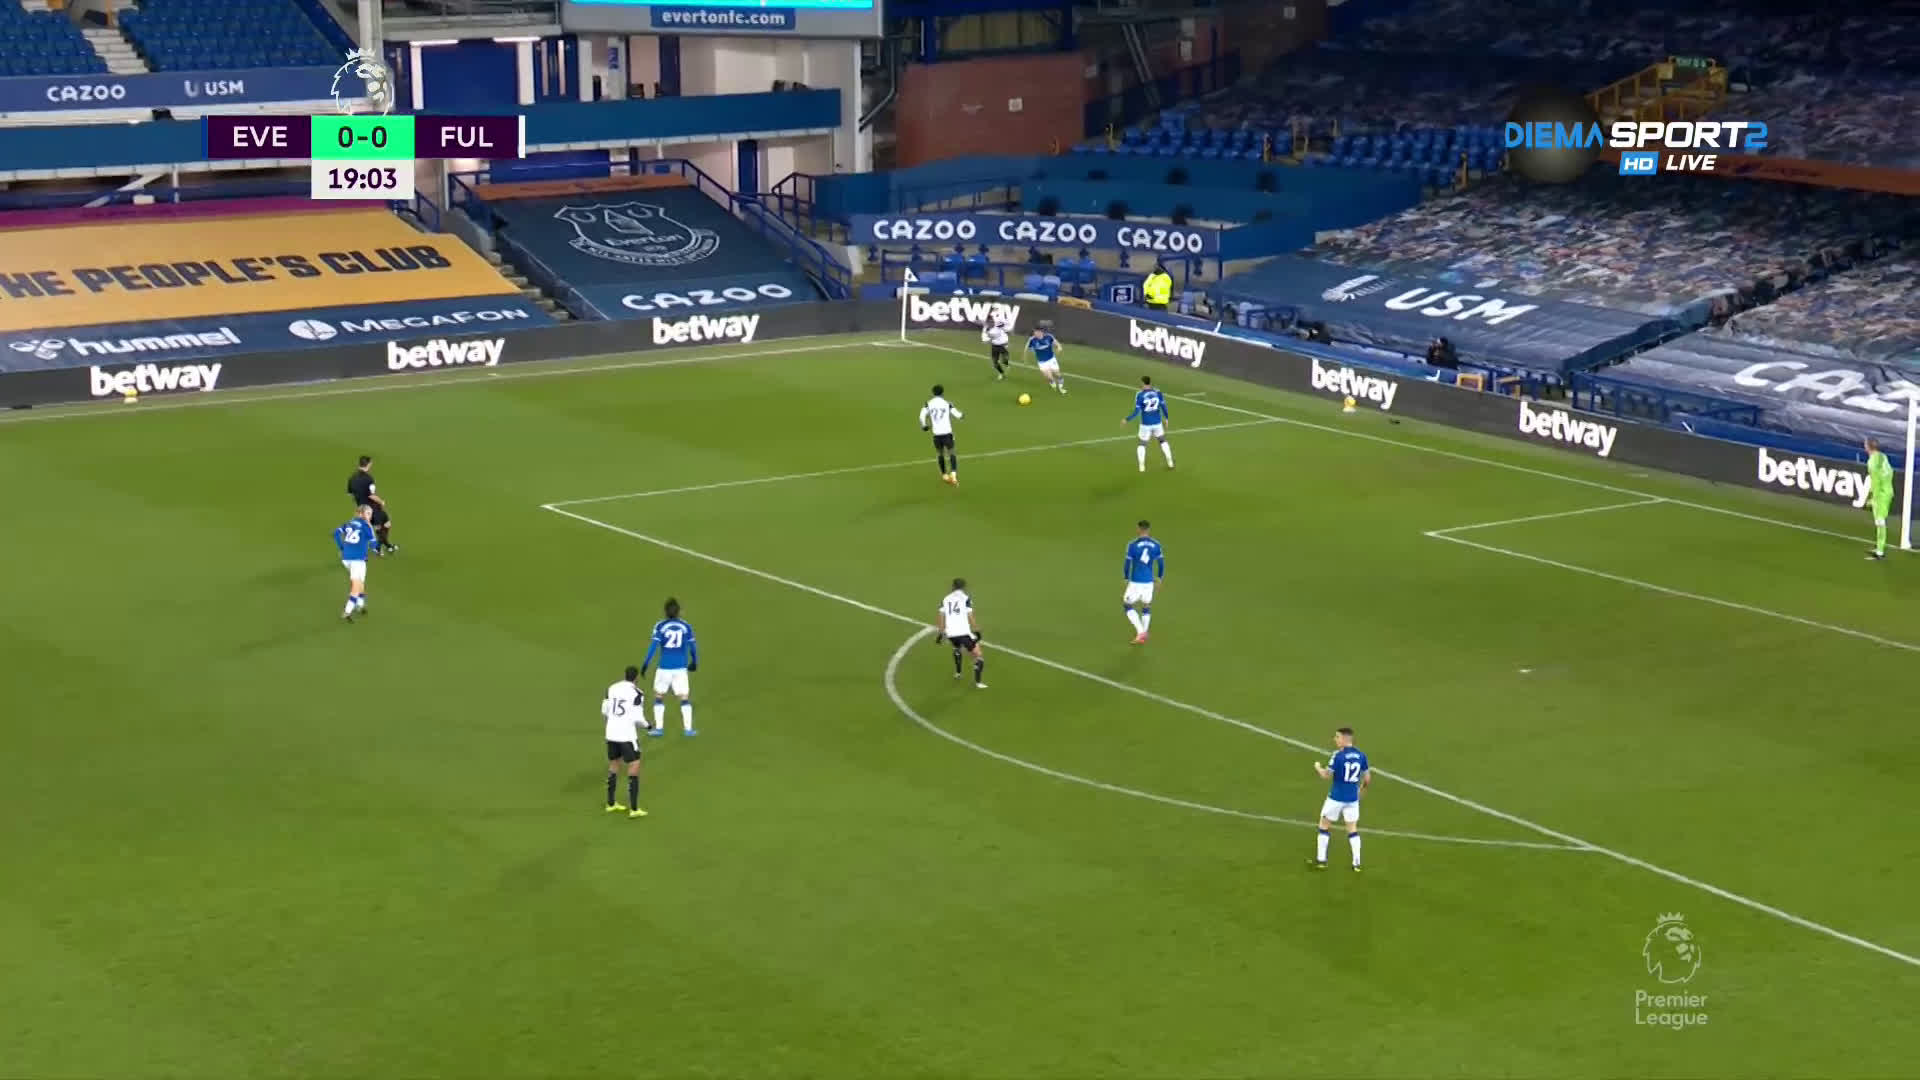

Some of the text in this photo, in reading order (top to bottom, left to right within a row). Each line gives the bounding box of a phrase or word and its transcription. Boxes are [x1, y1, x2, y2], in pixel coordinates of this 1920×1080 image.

[662, 10, 786, 25] evertonfc.com
[46, 84, 126, 102] CAZOO
[205, 79, 245, 96] USM
[873, 219, 1203, 254] CAZOO CAZOO CAZOO
[0, 245, 452, 299] HE PEOPLE'S CLUB
[621, 283, 793, 311] CAZOO
[909, 294, 1020, 331] betway
[1384, 287, 1539, 325] USM
[340, 308, 530, 334] MEGAFON
[652, 314, 760, 345] betway
[68, 326, 242, 356] hummel
[387, 338, 506, 371] betway
[1129, 319, 1206, 368] betway
[89, 362, 223, 397] betway
[1311, 358, 1398, 410] betway
[1733, 361, 1920, 413] CAZ
[1518, 401, 1618, 457] betway
[1758, 447, 1873, 508] betway
[947, 601, 961, 616] 14
[664, 628, 683, 649] 21
[612, 697, 627, 716] 15
[1343, 761, 1361, 783] 12
